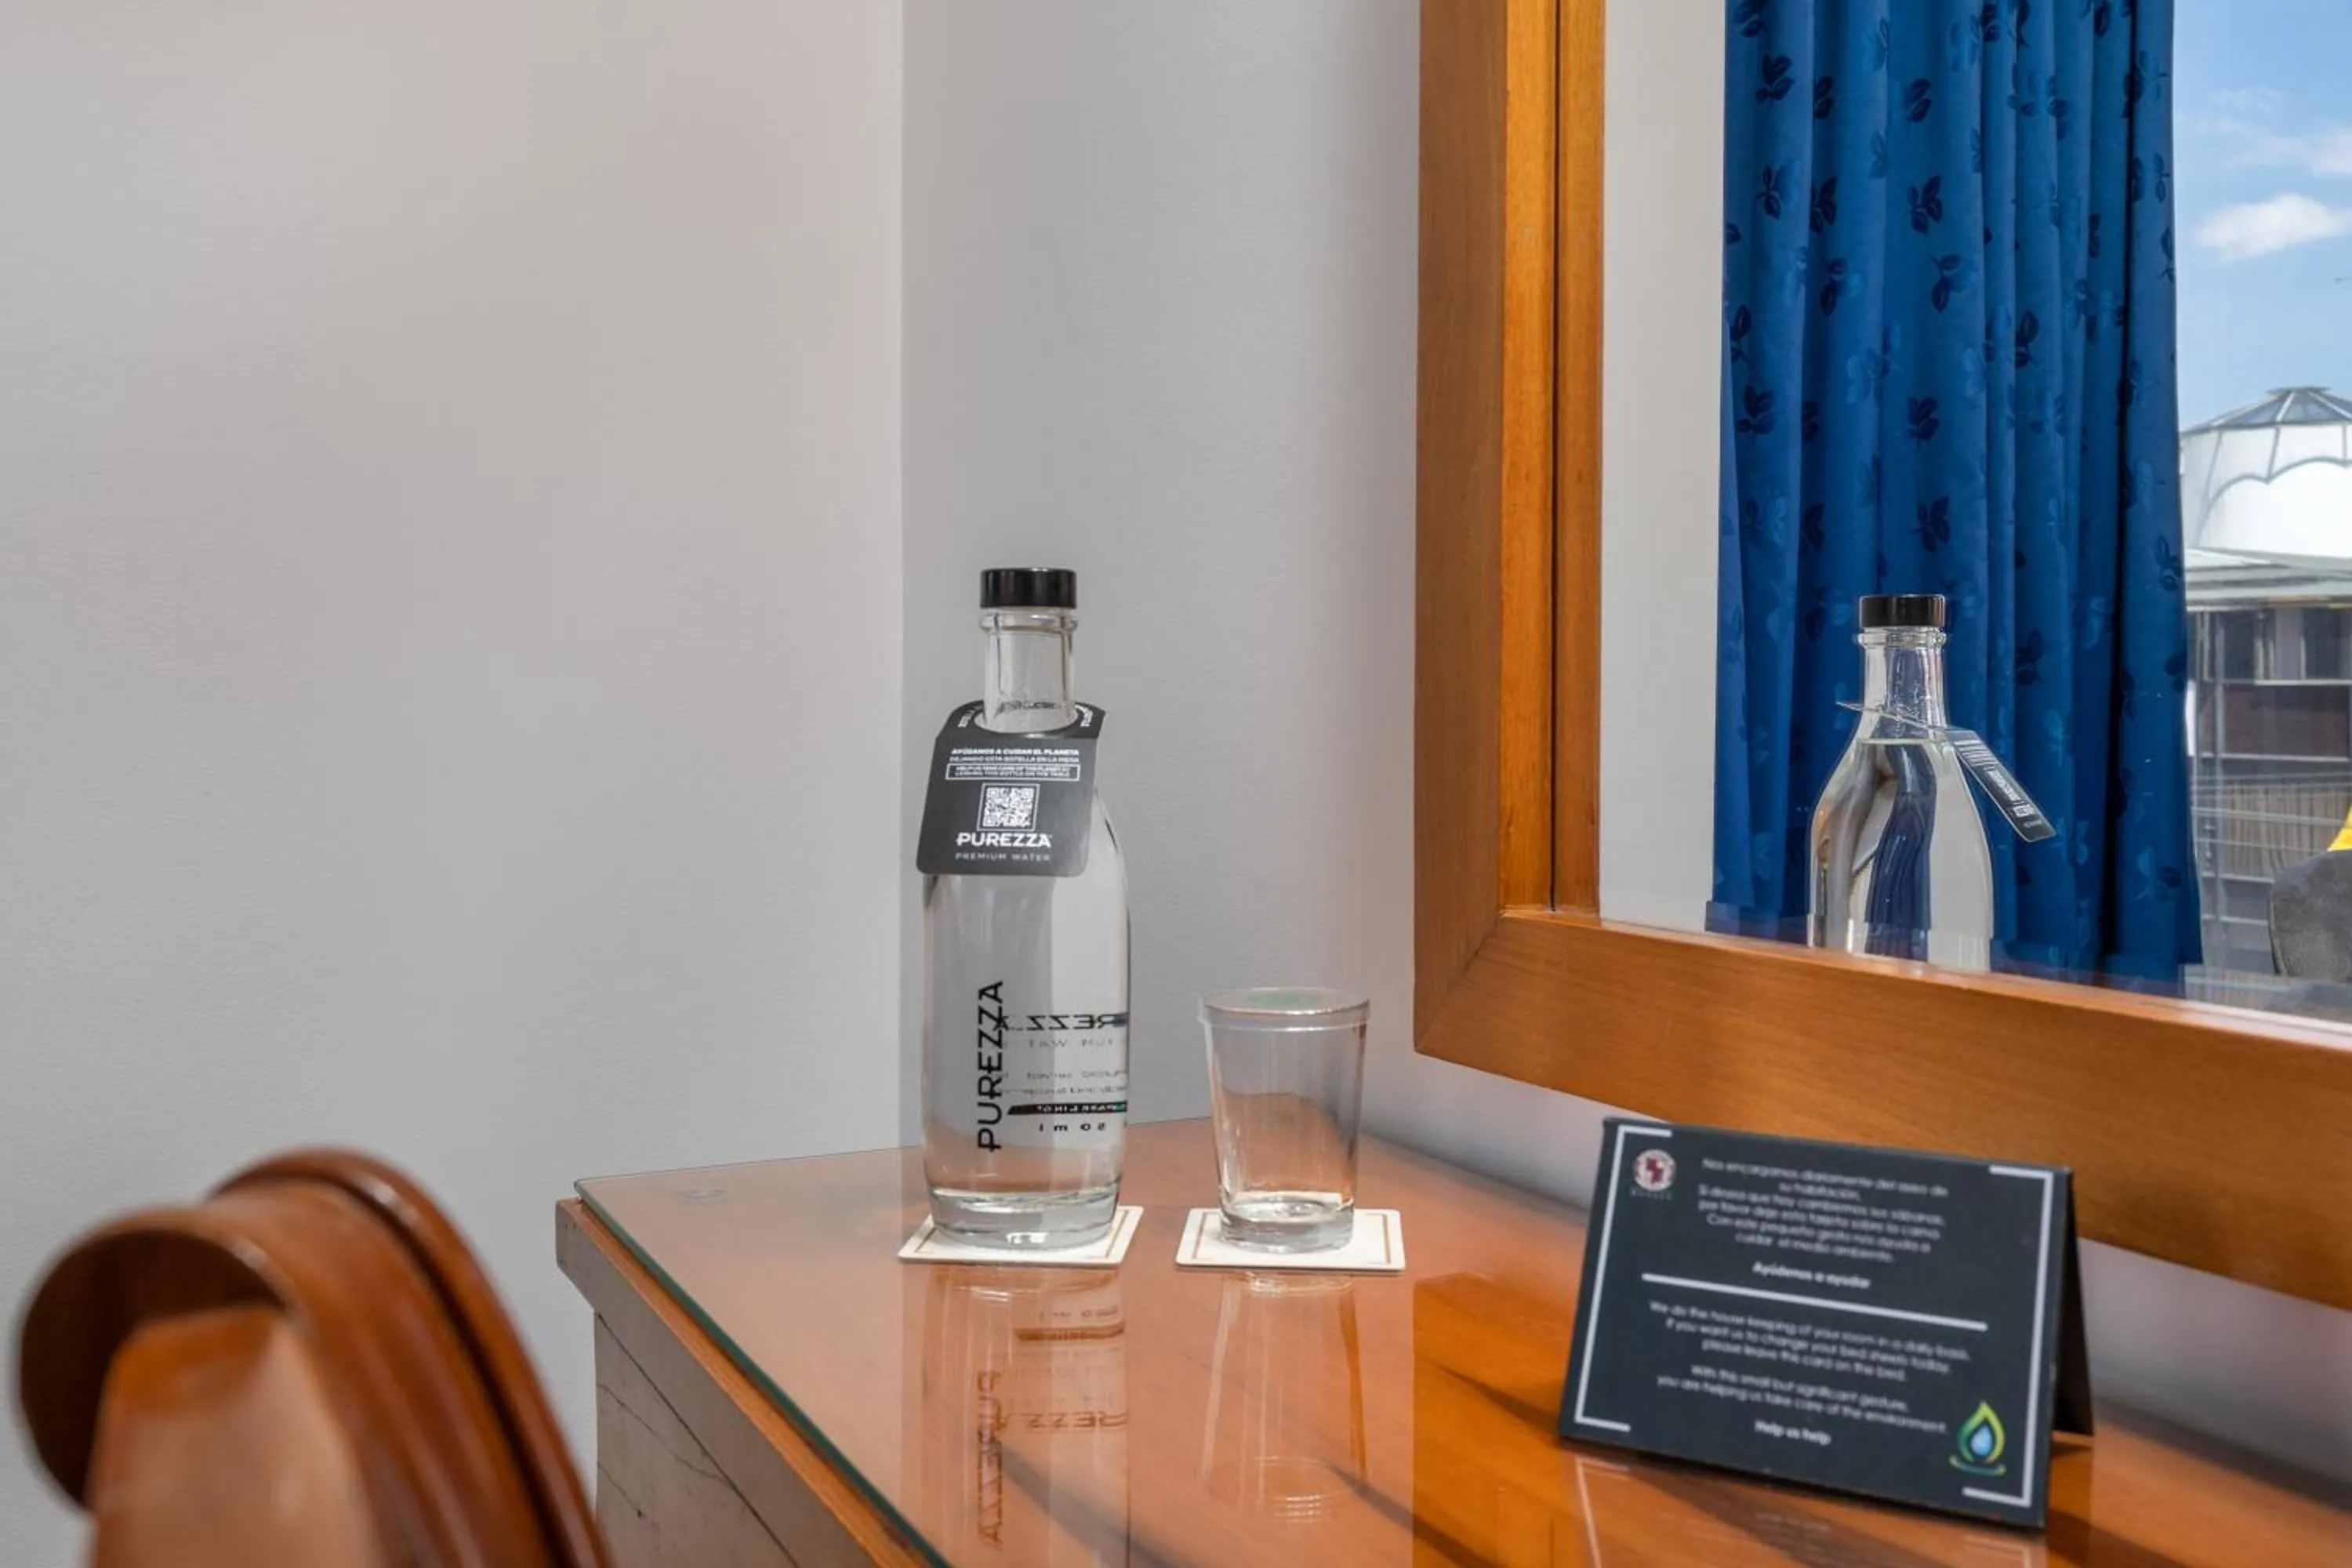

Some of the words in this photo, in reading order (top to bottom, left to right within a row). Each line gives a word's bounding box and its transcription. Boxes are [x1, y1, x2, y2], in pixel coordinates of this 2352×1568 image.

[956, 832, 1051, 848] PUREZZA
[955, 852, 1007, 861] PREMIUM
[1011, 853, 1051, 862] WATER
[978, 980, 1004, 1152] PUREZZA
[1814, 1272, 1825, 1283] a
[1826, 1273, 1871, 1289] ayudar
[1754, 1418, 1785, 1438] Help
[1786, 1427, 1801, 1440] us
[1802, 1428, 1831, 1446] help
